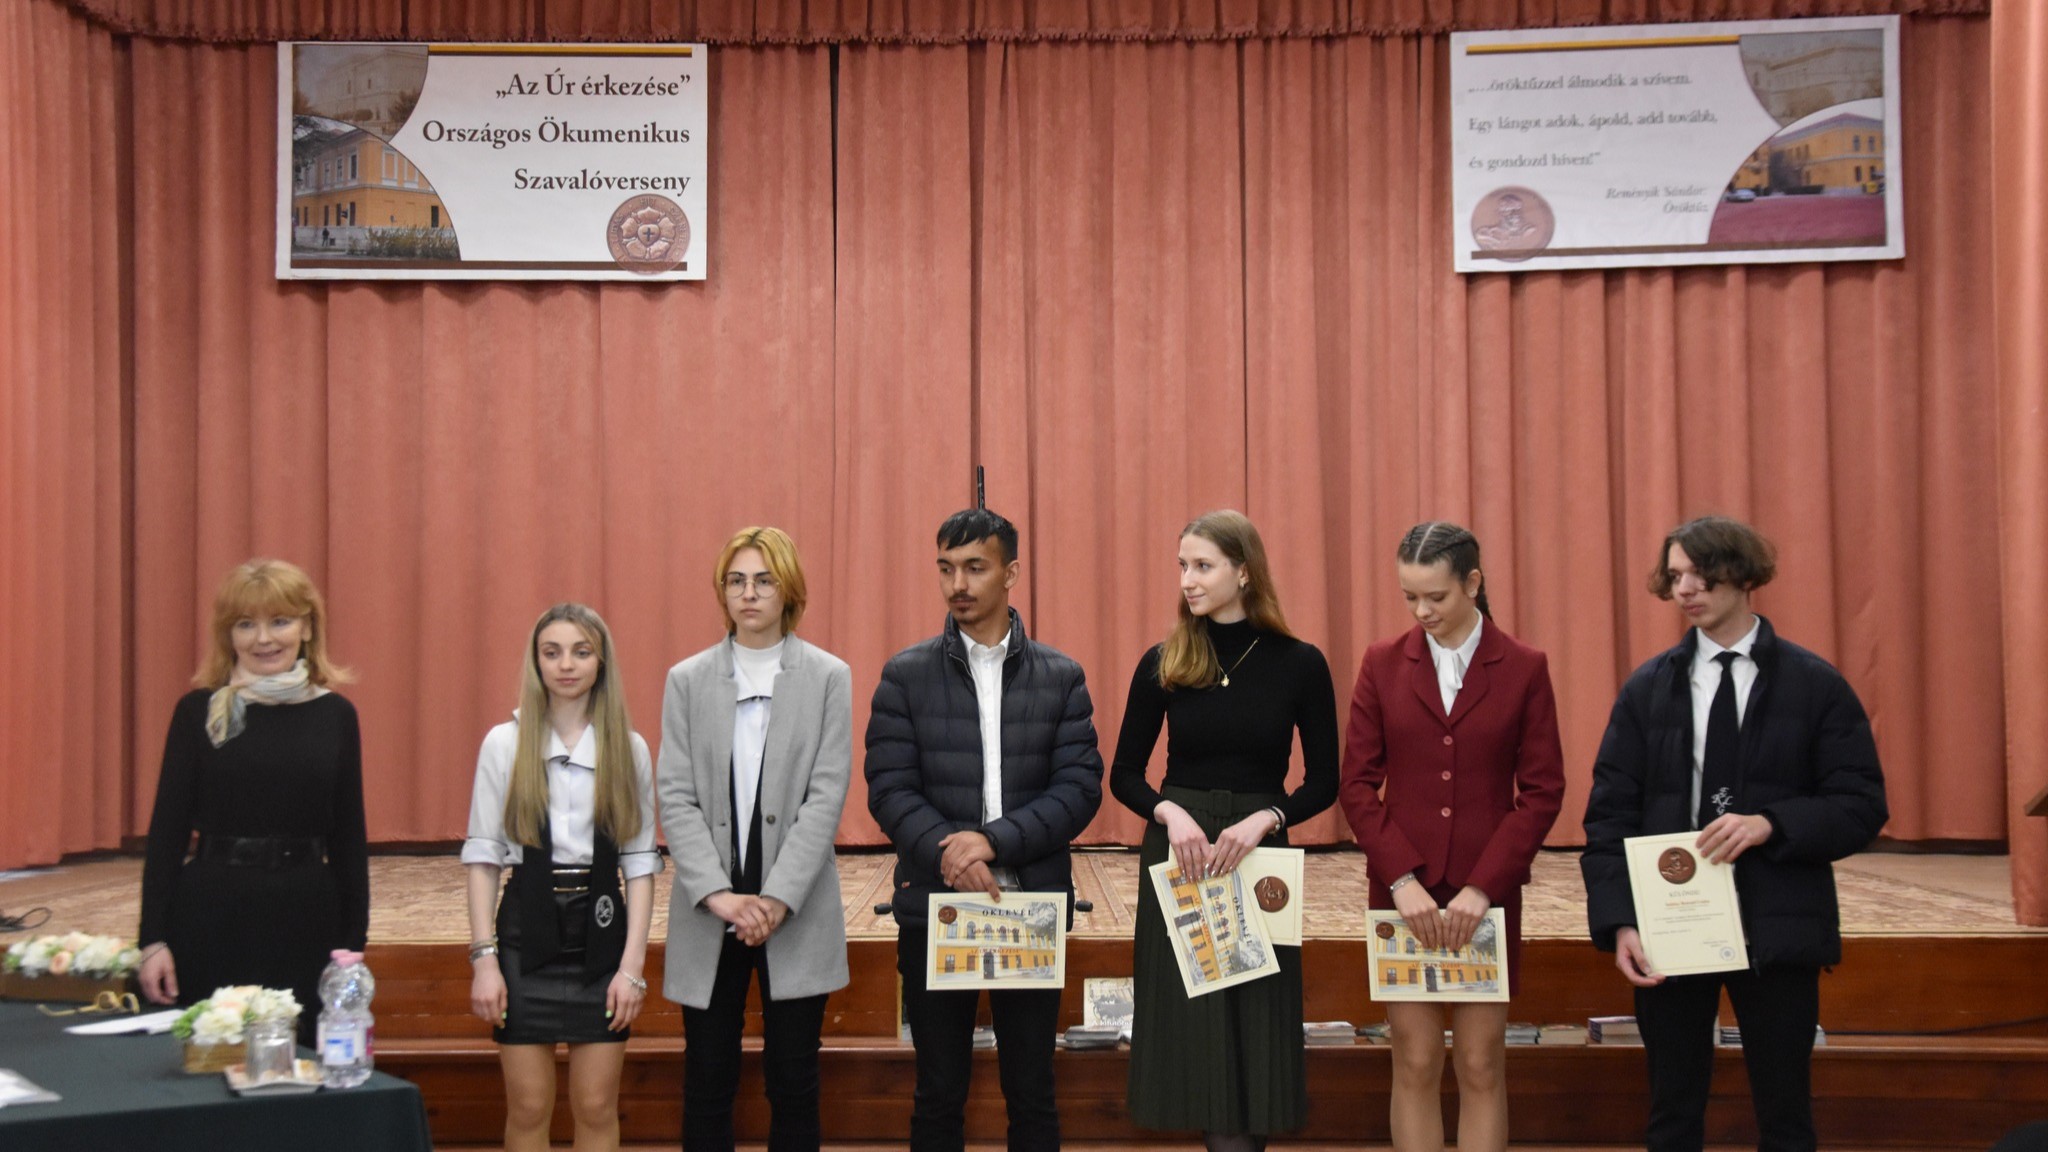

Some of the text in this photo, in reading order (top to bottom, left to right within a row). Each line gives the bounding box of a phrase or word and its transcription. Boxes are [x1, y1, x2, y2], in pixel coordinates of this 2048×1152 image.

[495, 68, 691, 99] „Az Úr érkezése”
[1629, 78, 1639, 87] a
[422, 116, 691, 149] Országos Ökumenikus
[1469, 117, 1492, 134] Egy
[1498, 115, 1541, 133] lángot
[1637, 110, 1664, 125] add
[1469, 156, 1484, 169] és
[1487, 153, 1548, 172] gondozd
[514, 168, 691, 197] Szavalóverseny
